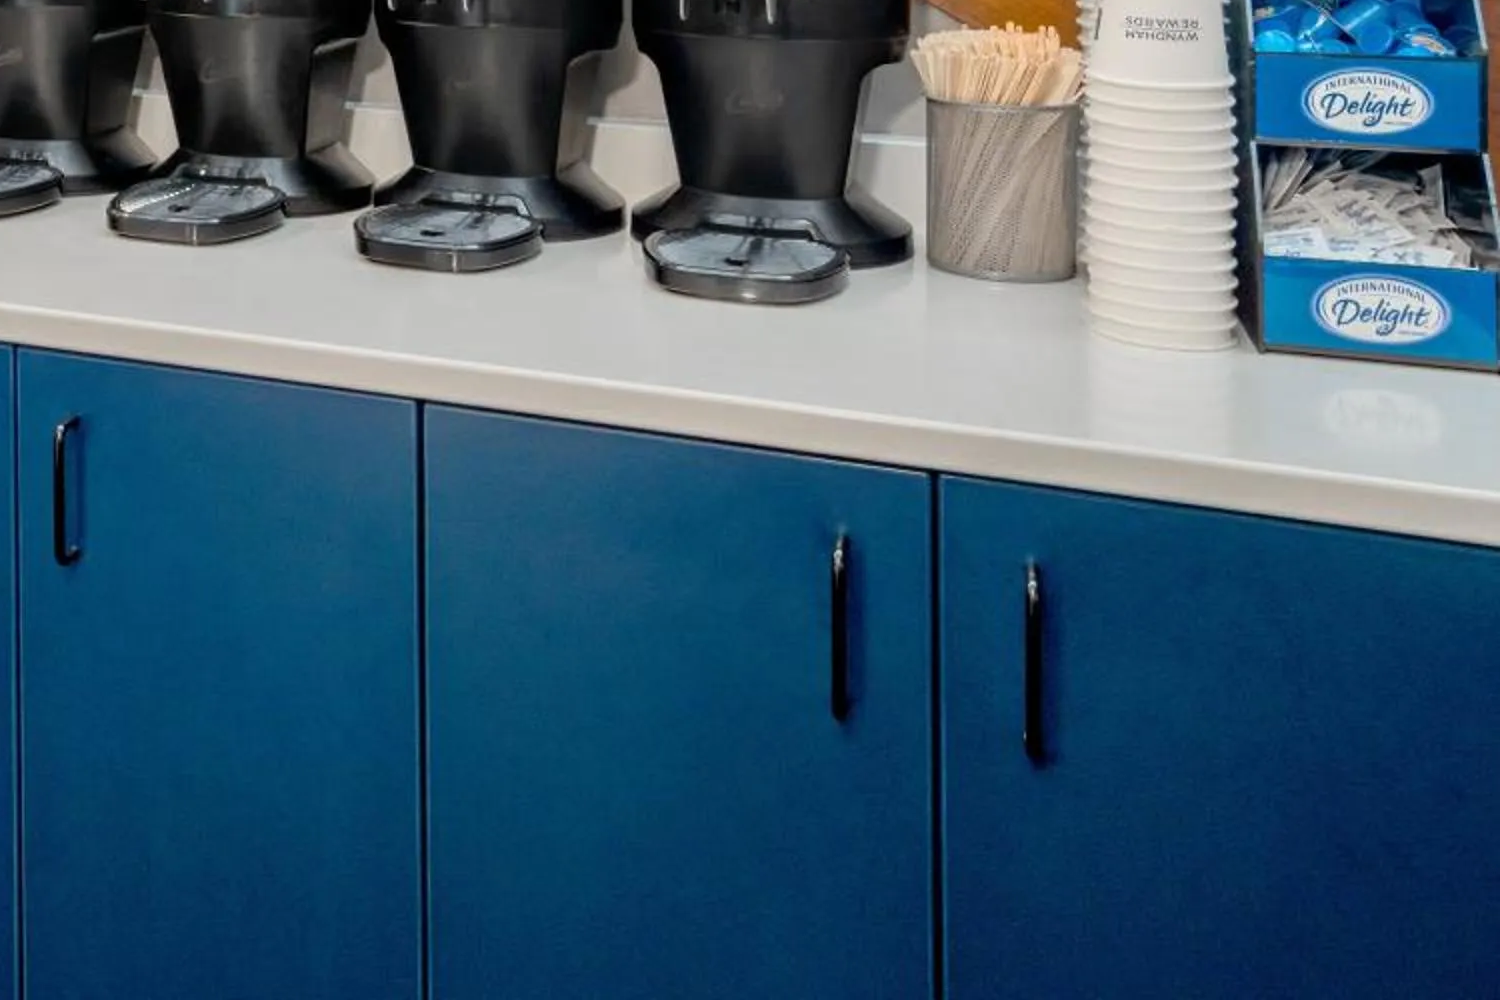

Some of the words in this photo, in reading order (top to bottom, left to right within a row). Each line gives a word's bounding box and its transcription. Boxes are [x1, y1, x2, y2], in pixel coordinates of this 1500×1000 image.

[1124, 15, 1200, 29] REWARDS
[1124, 30, 1199, 41] WYNDHAM
[1324, 76, 1411, 93] INTERNATIONAL
[1320, 91, 1416, 127] Delight
[1337, 281, 1425, 301] INTERNATIONAL
[1331, 298, 1431, 336] Delight
